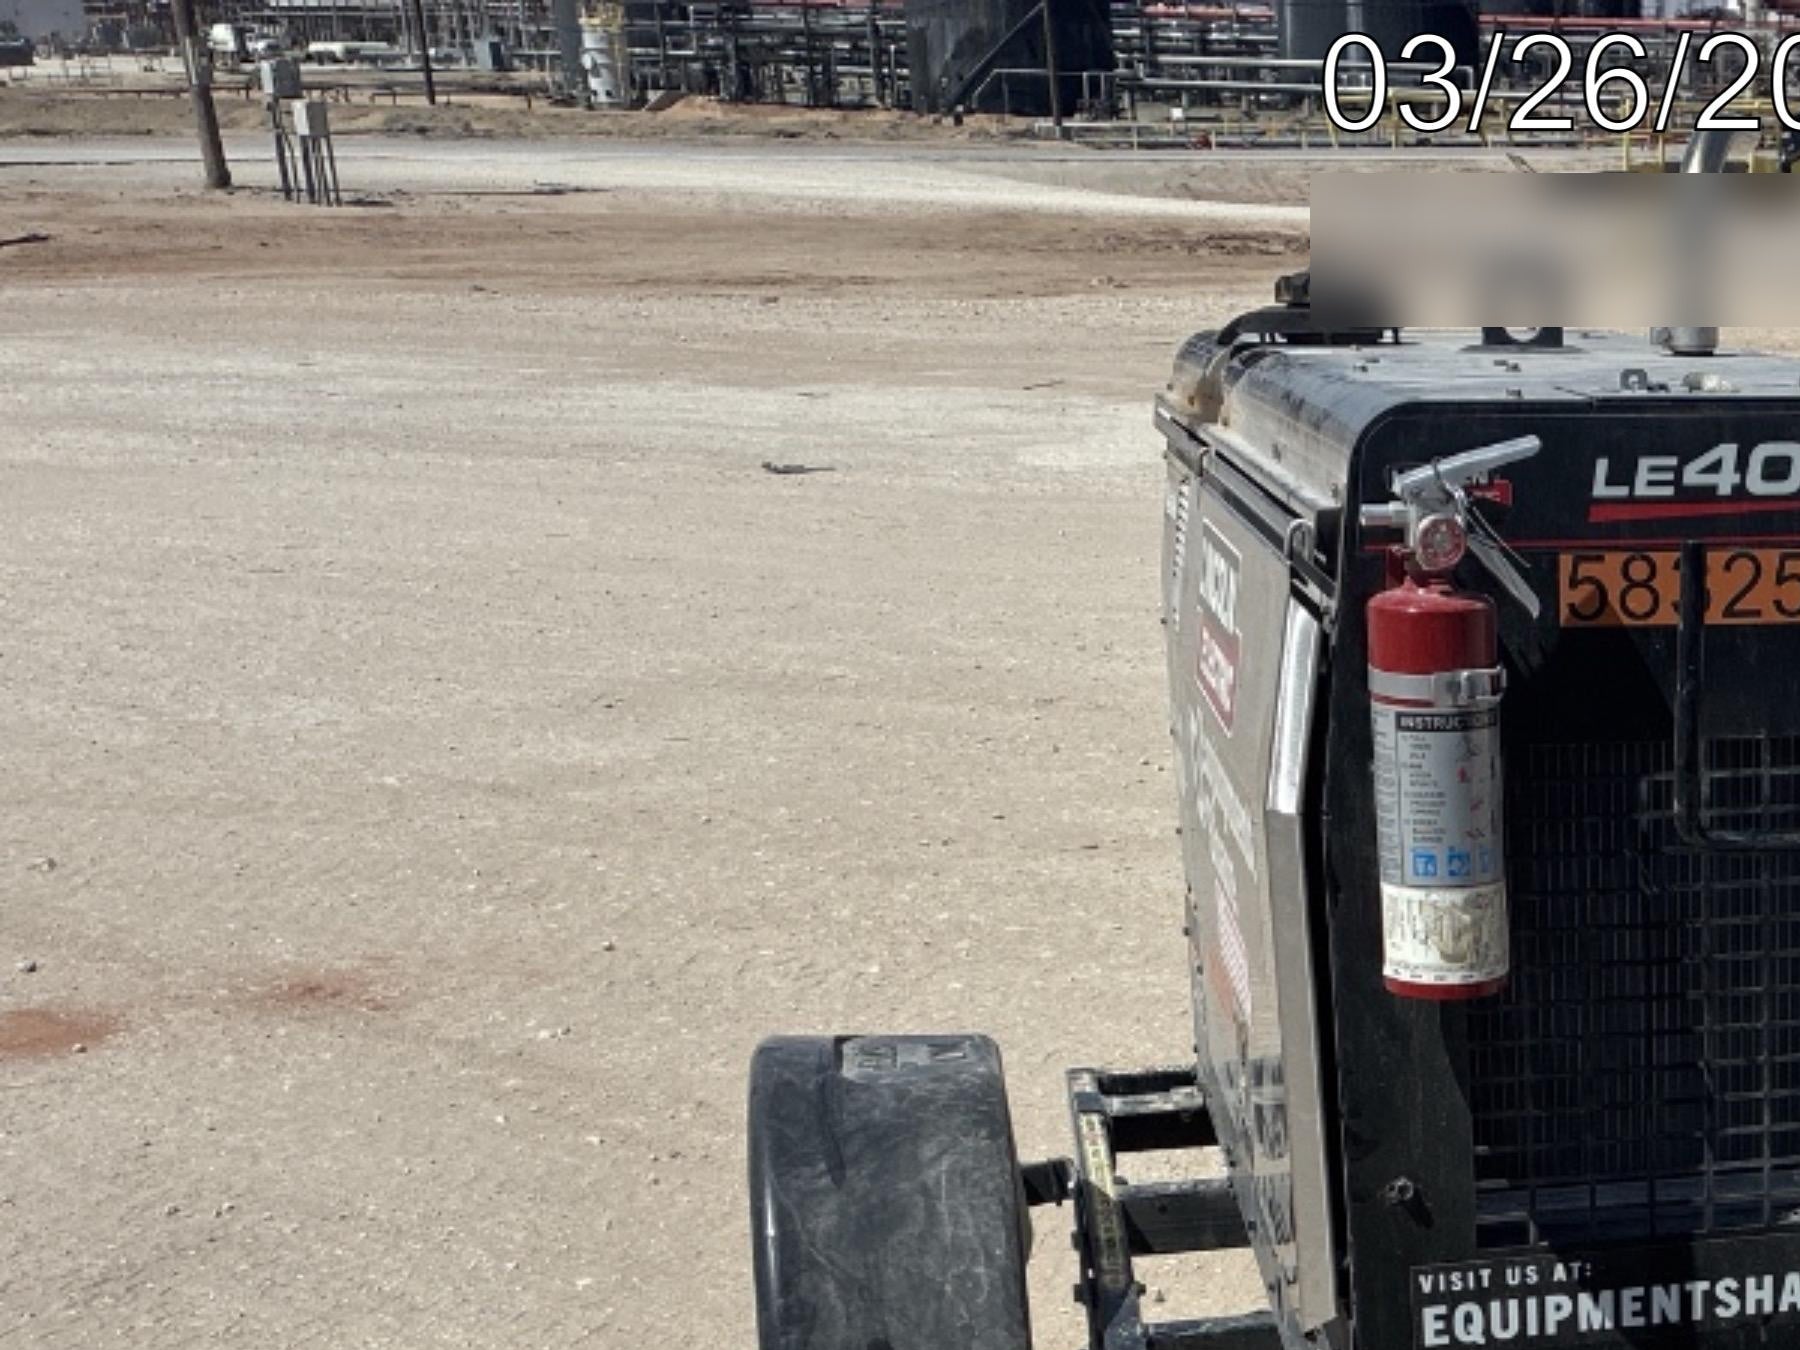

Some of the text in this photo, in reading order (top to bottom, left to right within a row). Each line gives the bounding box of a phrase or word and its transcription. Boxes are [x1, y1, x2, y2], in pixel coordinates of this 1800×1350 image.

[1418, 1261, 1592, 1294] VISIT US AT:
